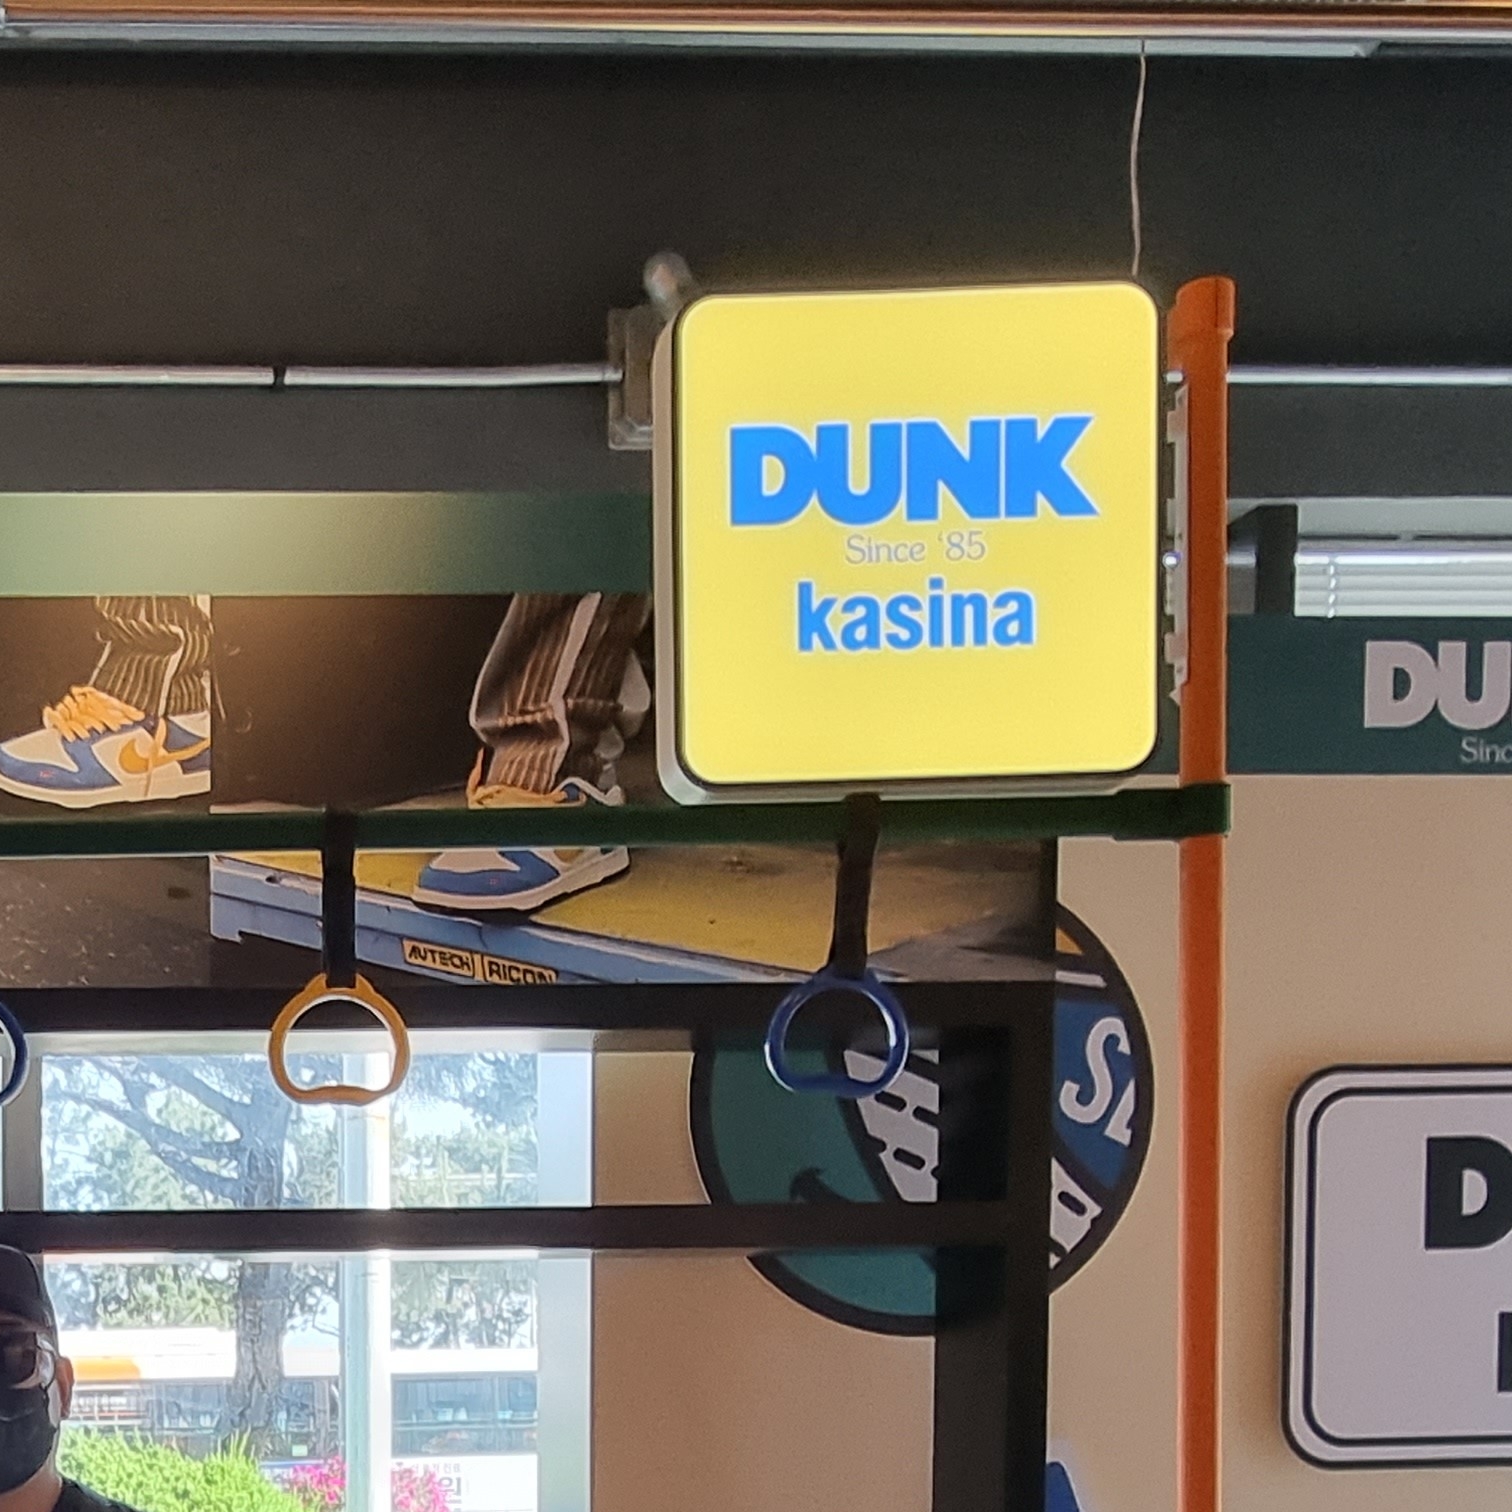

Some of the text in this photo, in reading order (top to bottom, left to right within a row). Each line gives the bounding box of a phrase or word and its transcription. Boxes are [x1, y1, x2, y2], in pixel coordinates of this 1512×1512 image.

[730, 415, 1099, 526] DUNK
[845, 533, 926, 564] Since
[797, 577, 1034, 652] kasina
[1364, 640, 1512, 730] DU
